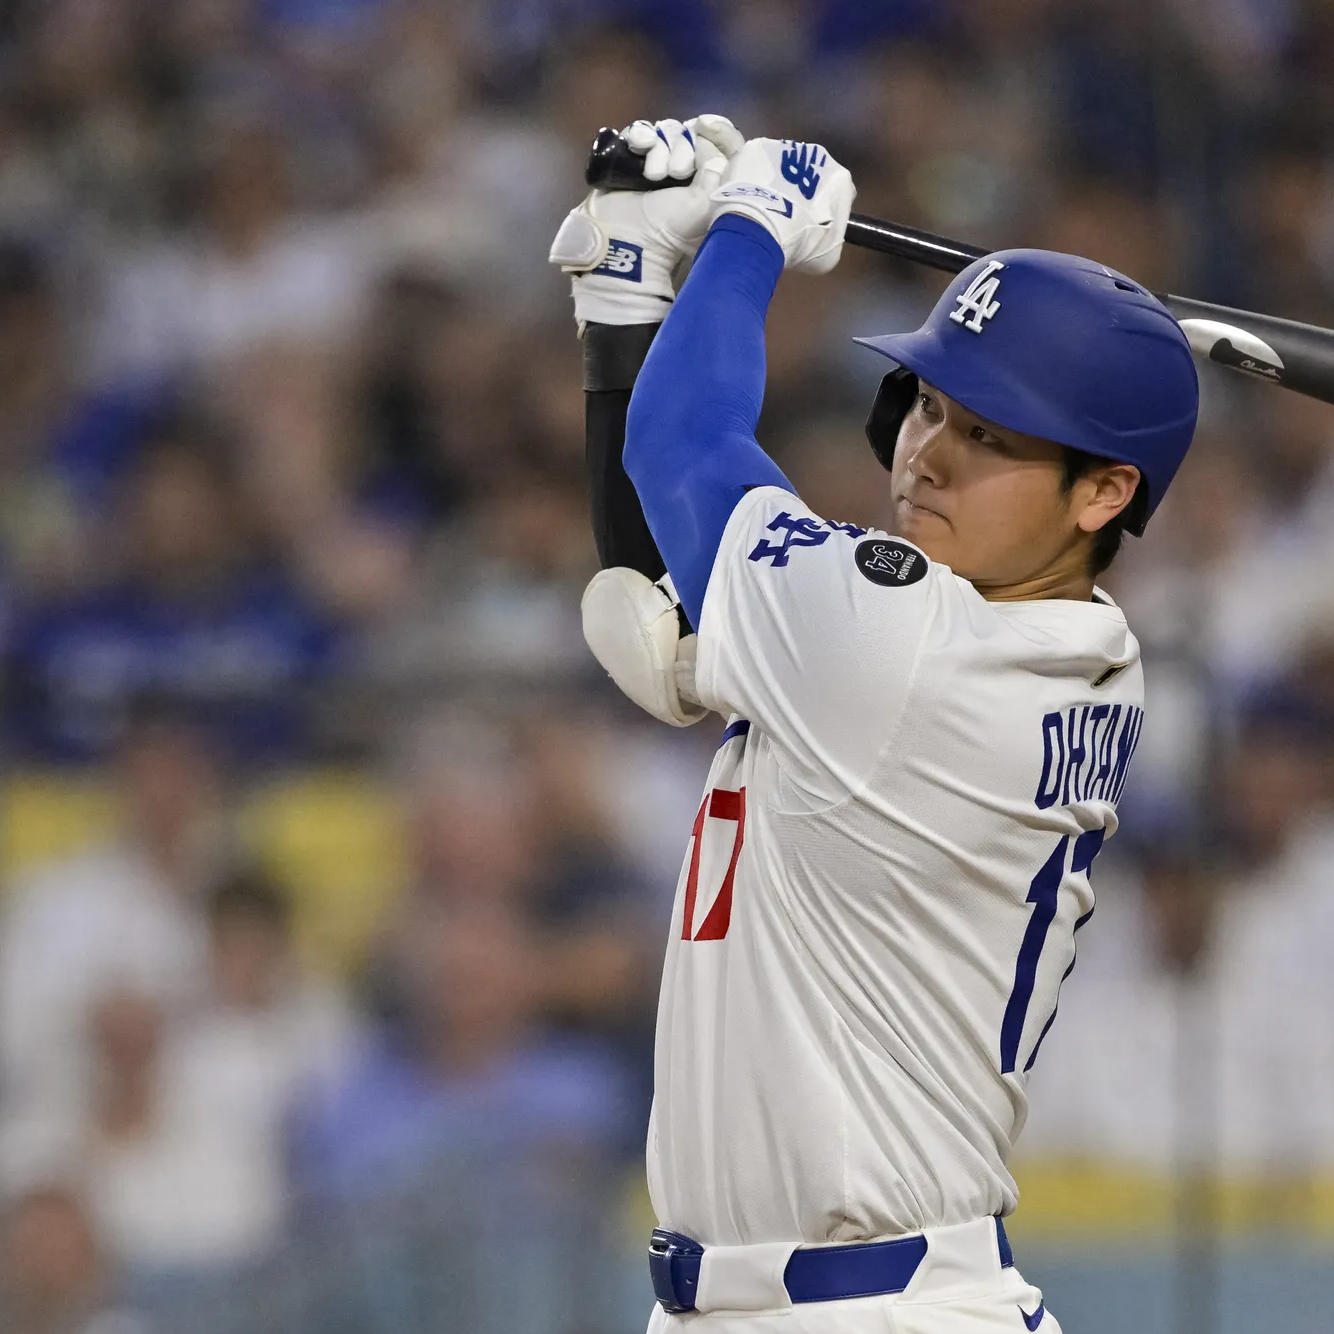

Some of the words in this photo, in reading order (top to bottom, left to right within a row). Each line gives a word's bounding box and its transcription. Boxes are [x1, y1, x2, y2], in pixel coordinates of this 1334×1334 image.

[949, 260, 1005, 334] LA
[865, 545, 904, 575] 34
[897, 552, 917, 581] FERNANDO
[681, 785, 747, 942] 17
